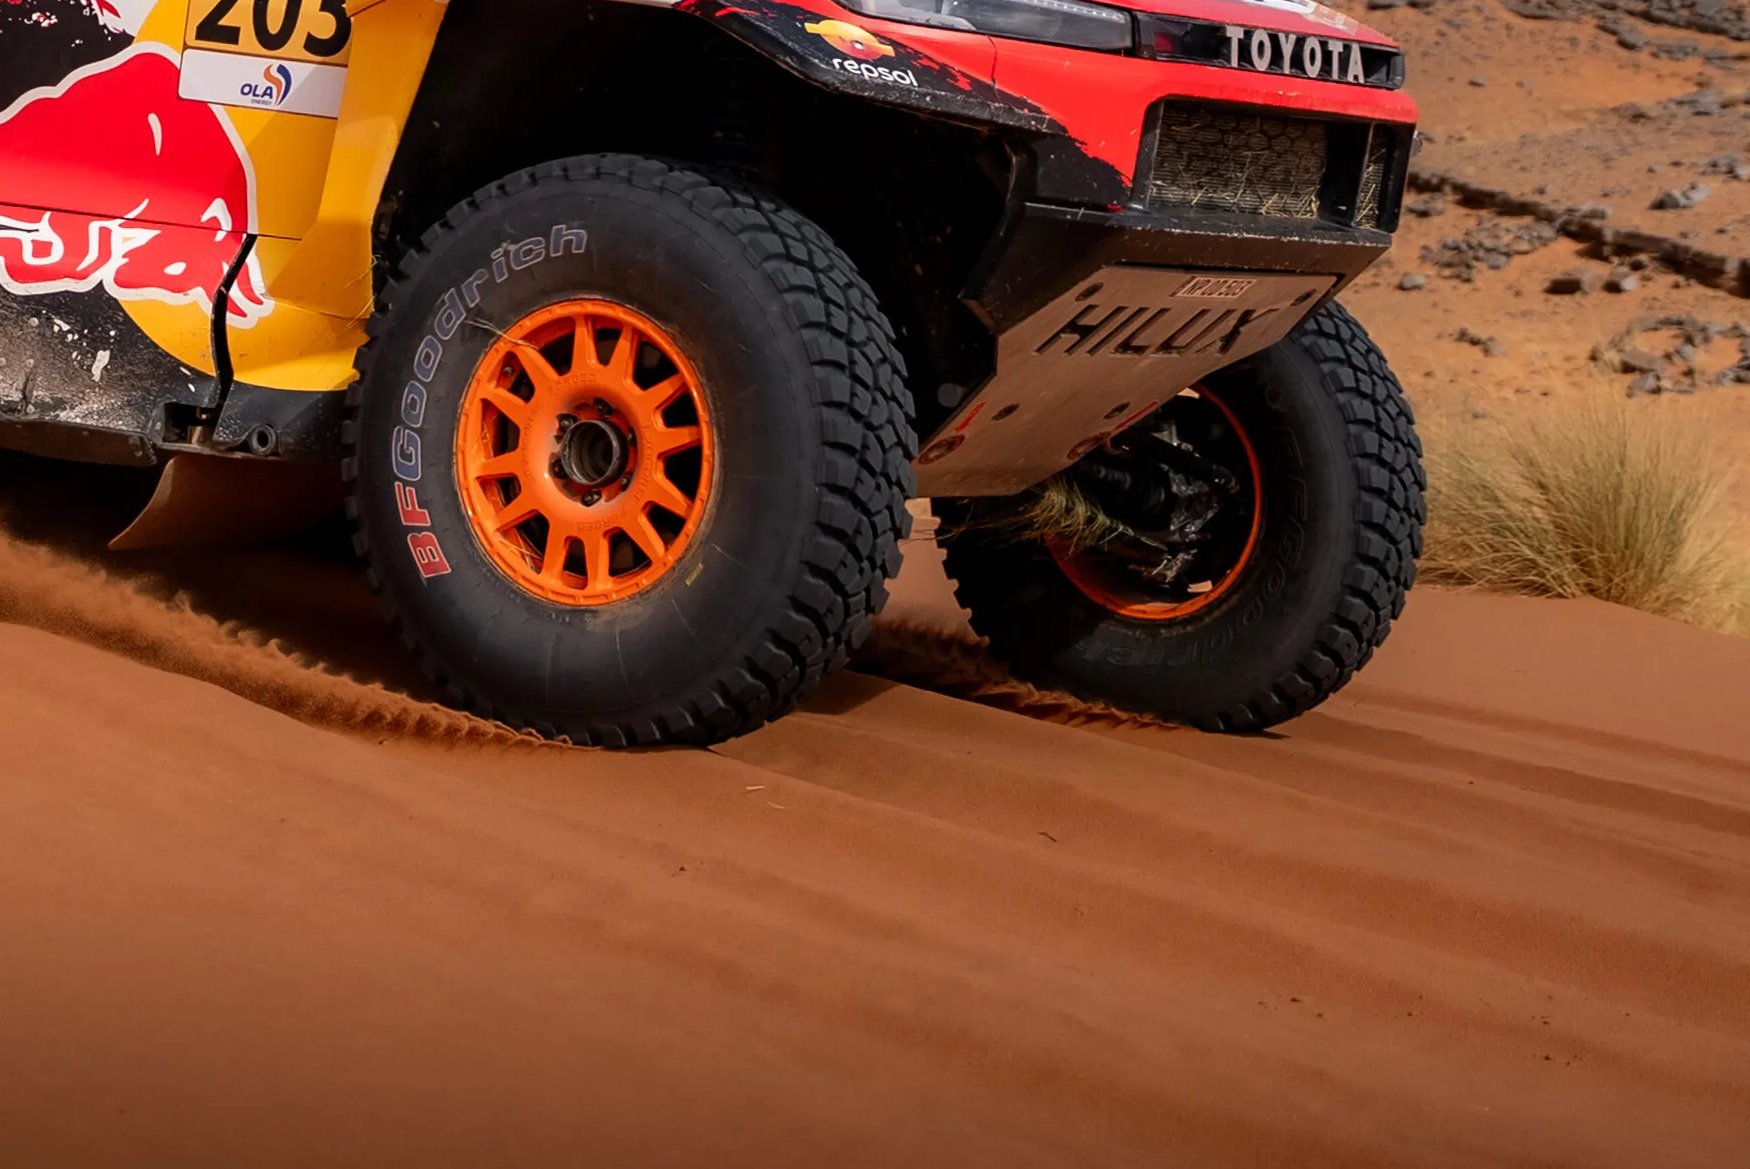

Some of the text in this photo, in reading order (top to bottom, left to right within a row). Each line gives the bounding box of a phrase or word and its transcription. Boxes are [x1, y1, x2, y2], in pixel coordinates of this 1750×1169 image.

[832, 57, 919, 87] repsol
[1225, 25, 1365, 84] TOYOTA
[240, 83, 273, 99] OLA
[1033, 304, 1279, 357] HILUX
[392, 224, 588, 579] BFGoodrich
